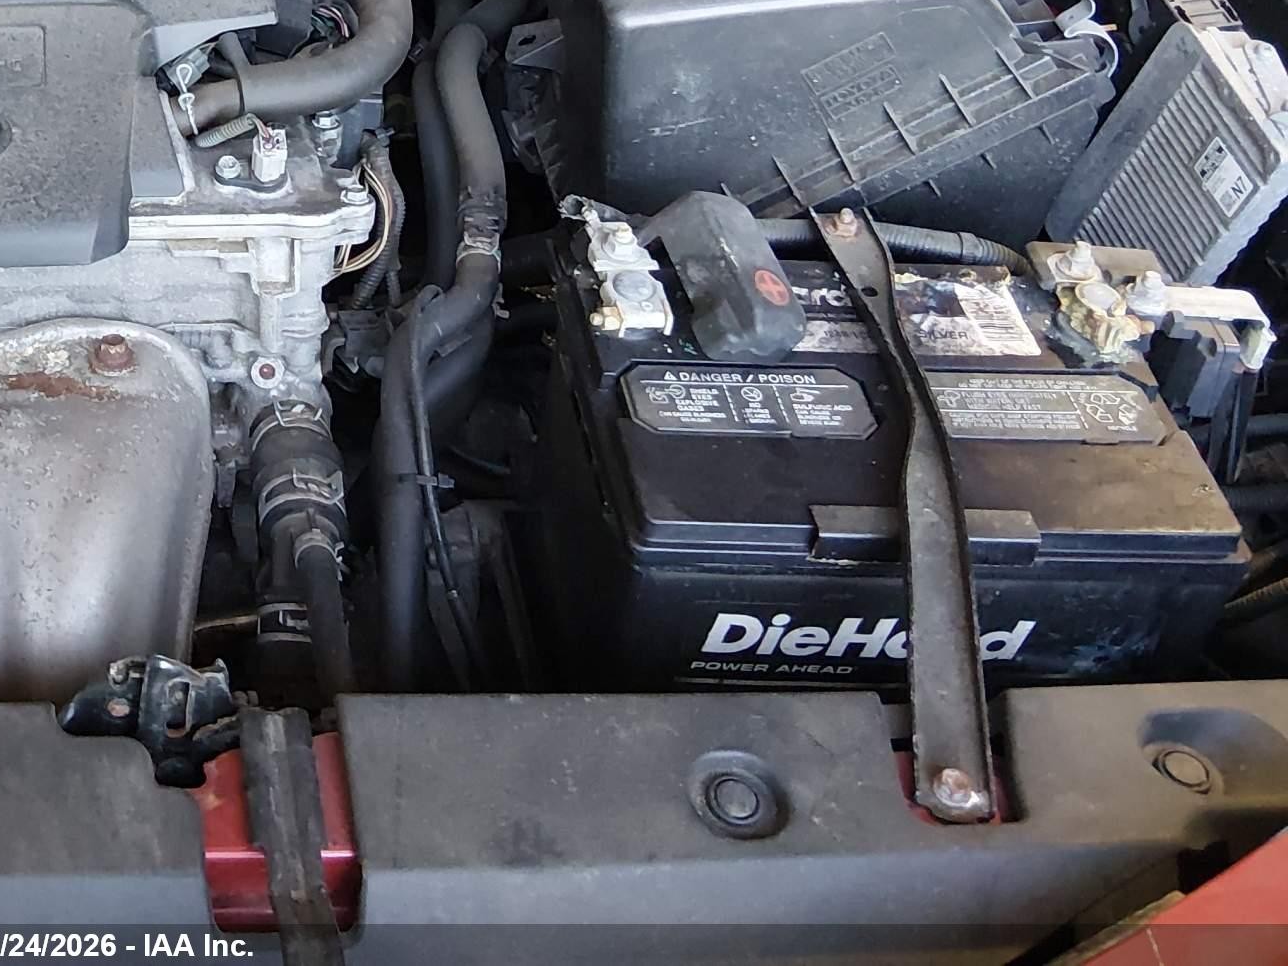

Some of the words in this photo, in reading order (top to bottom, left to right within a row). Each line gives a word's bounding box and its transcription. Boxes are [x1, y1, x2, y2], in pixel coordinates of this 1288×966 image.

[1230, 176, 1248, 200] N7
[679, 371, 742, 383] DANGER
[746, 372, 753, 383] /
[758, 373, 817, 385] POISON
[690, 661, 769, 673] POWER
[775, 664, 854, 674] AHEAD
